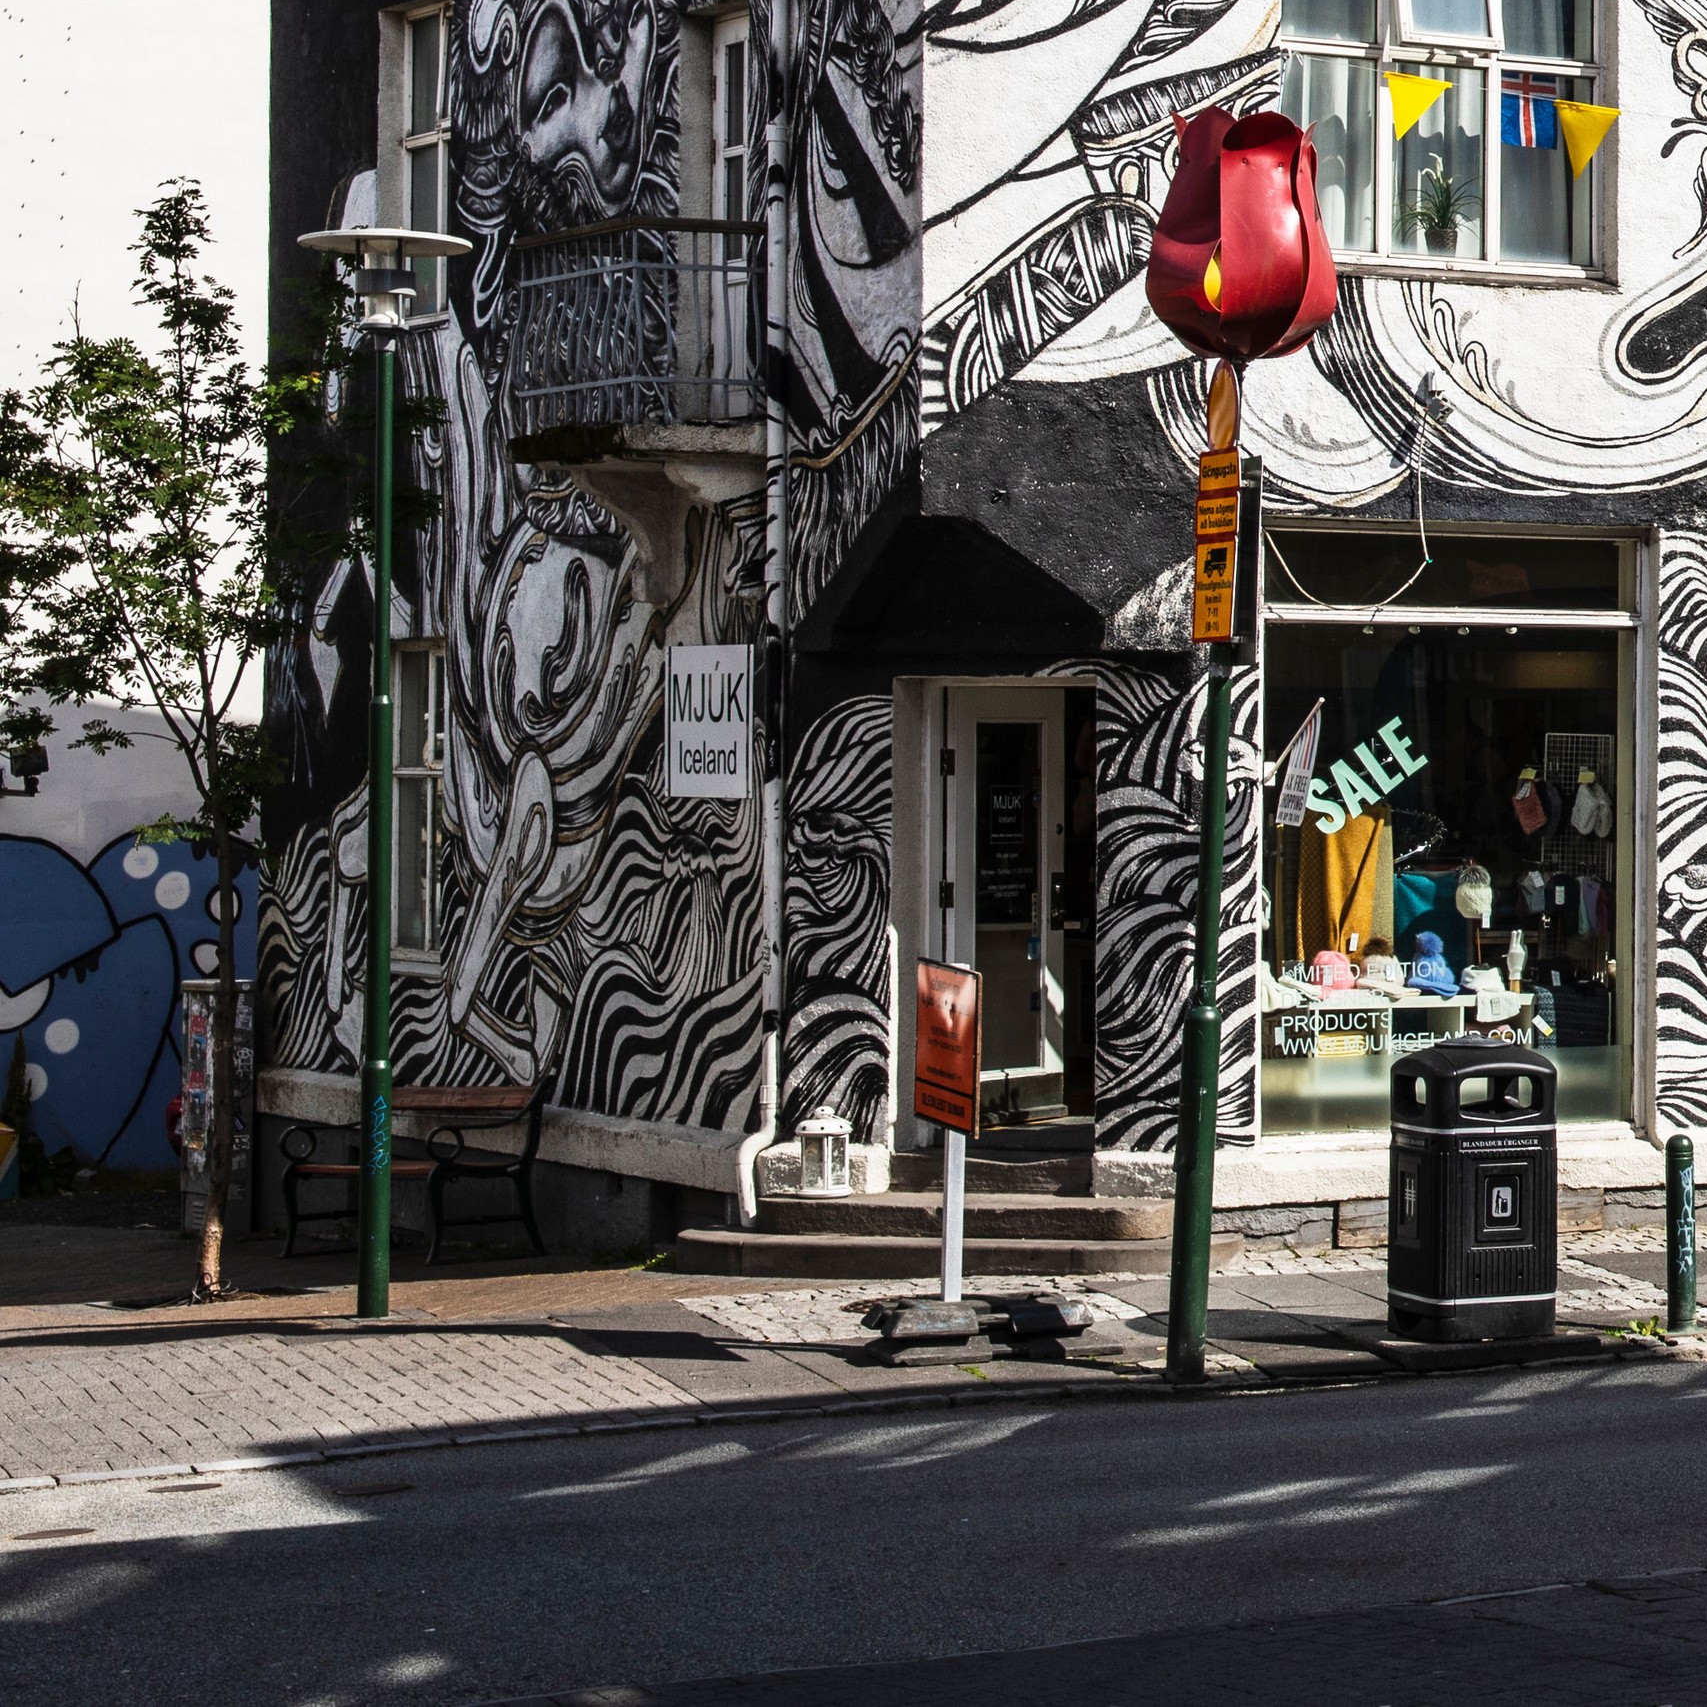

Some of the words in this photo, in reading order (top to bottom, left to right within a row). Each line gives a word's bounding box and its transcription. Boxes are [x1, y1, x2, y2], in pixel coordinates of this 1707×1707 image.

[673, 660, 746, 723] MJÚK
[679, 740, 737, 775] Iceland
[1305, 716, 1429, 835] SALE
[1282, 961, 1361, 983] LIMITED
[1282, 1011, 1392, 1035] PRODUCTS
